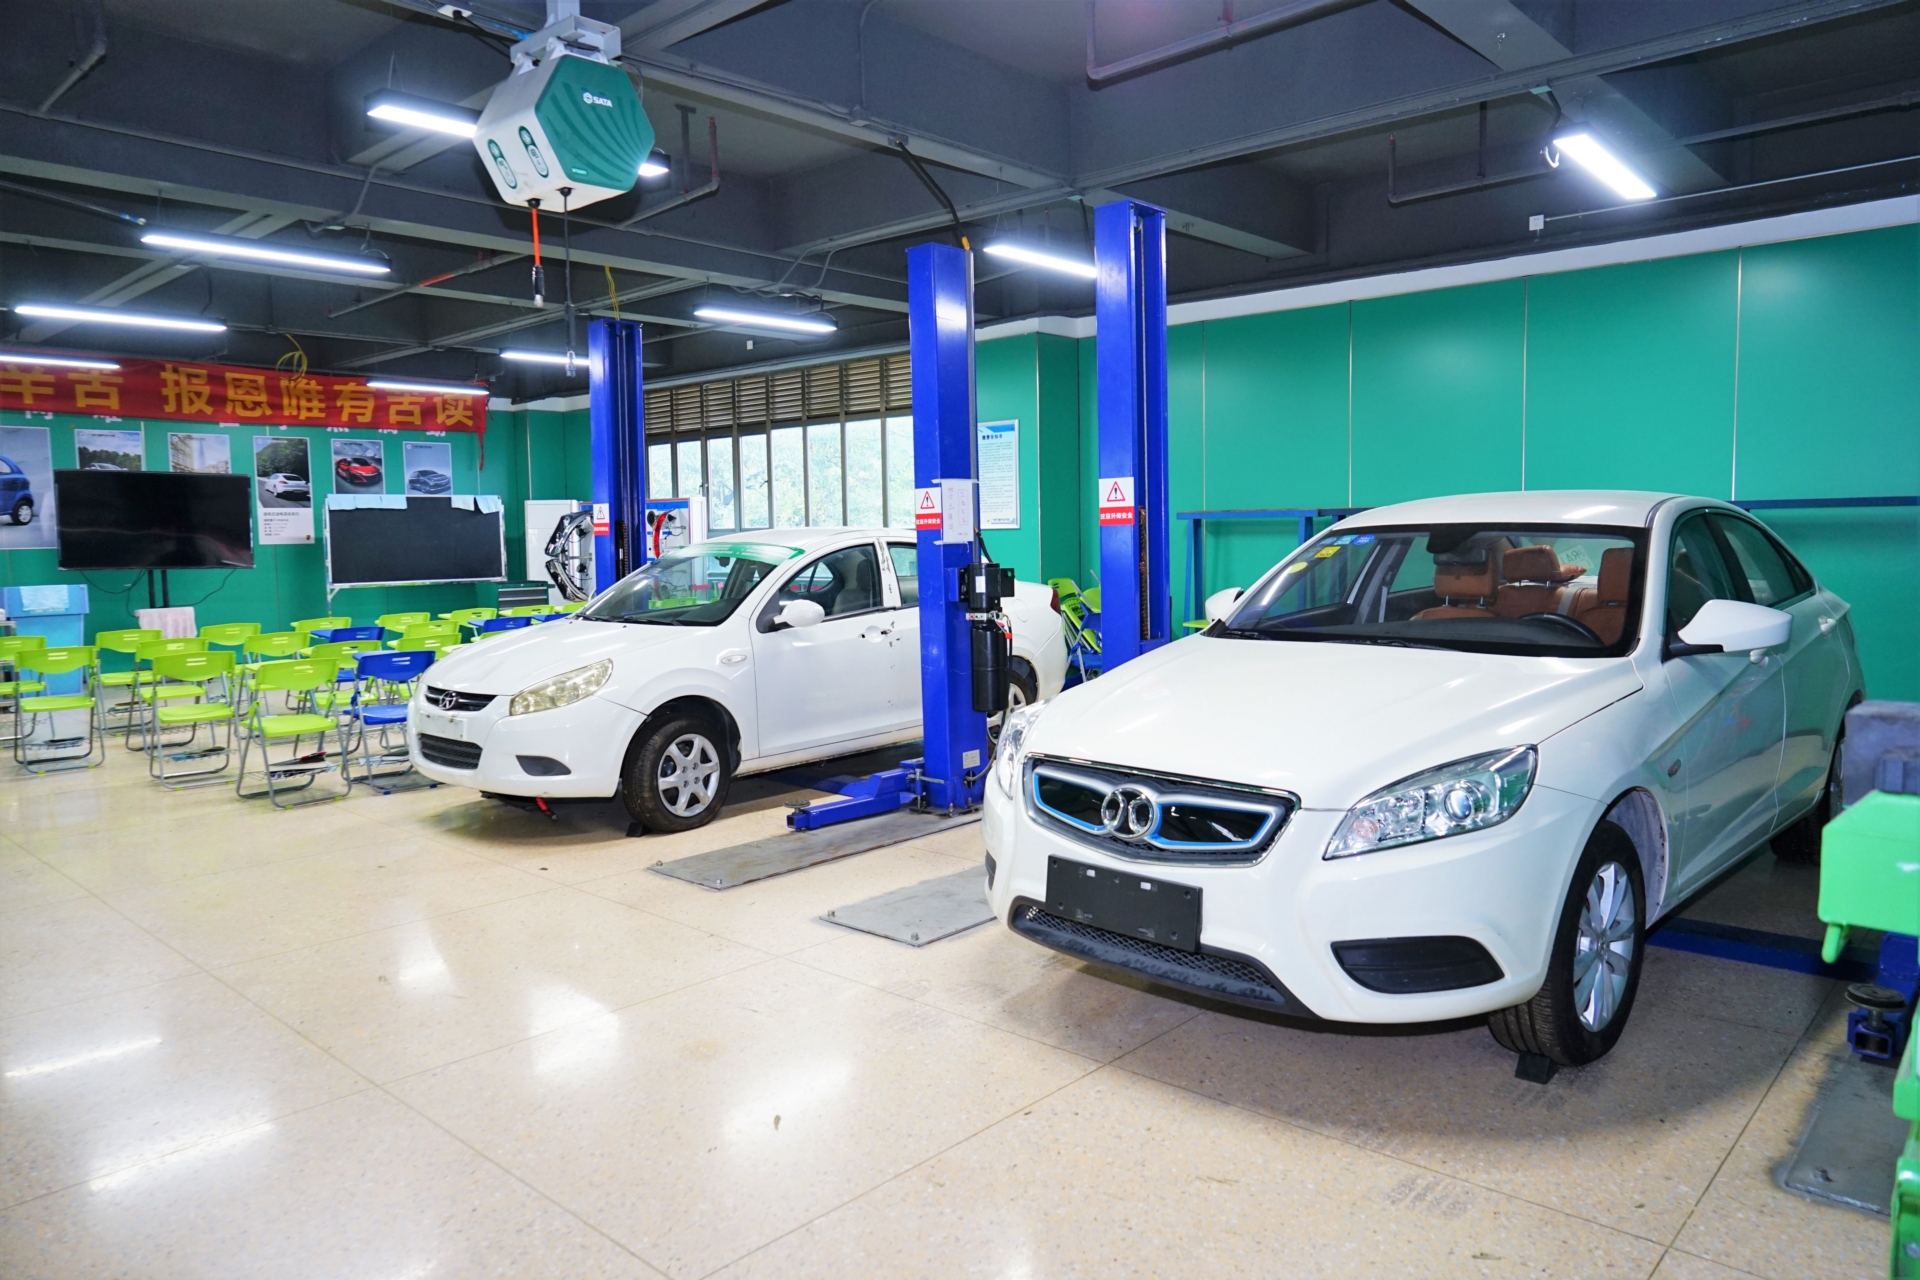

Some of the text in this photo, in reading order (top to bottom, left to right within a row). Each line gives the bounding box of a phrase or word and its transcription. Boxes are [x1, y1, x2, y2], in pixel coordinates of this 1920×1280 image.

[593, 96, 613, 108] SATA
[1100, 512, 1133, 520] 注意升降安全
